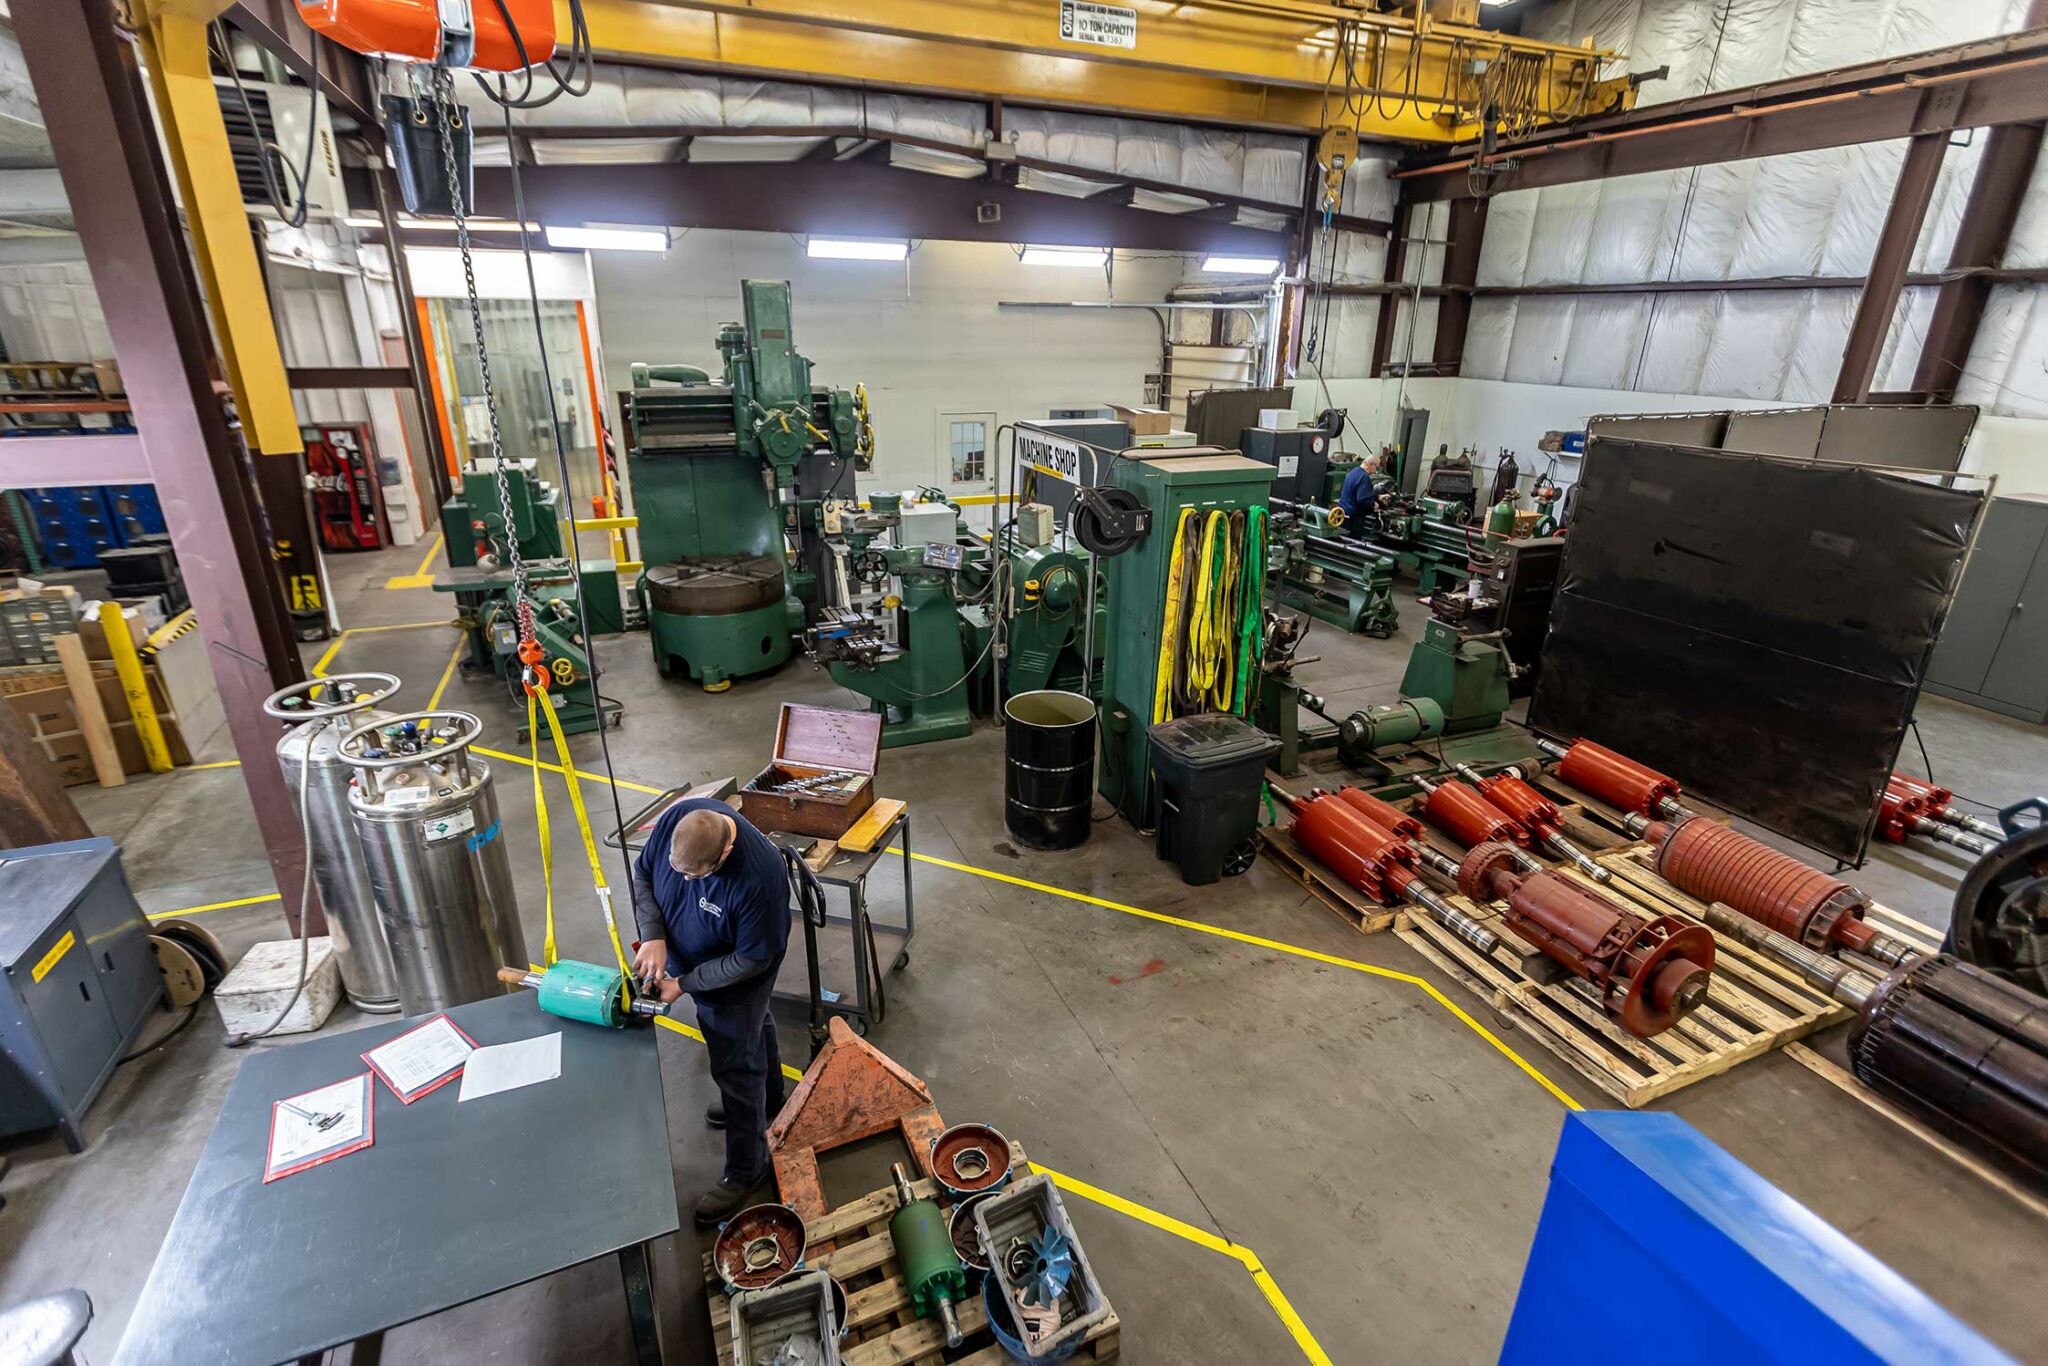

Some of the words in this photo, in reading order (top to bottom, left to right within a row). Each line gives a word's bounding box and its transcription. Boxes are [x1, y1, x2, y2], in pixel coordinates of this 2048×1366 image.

[1079, 19, 1088, 31] 10
[1019, 436, 1053, 470] MACHINE
[1054, 446, 1077, 477] SHOP
